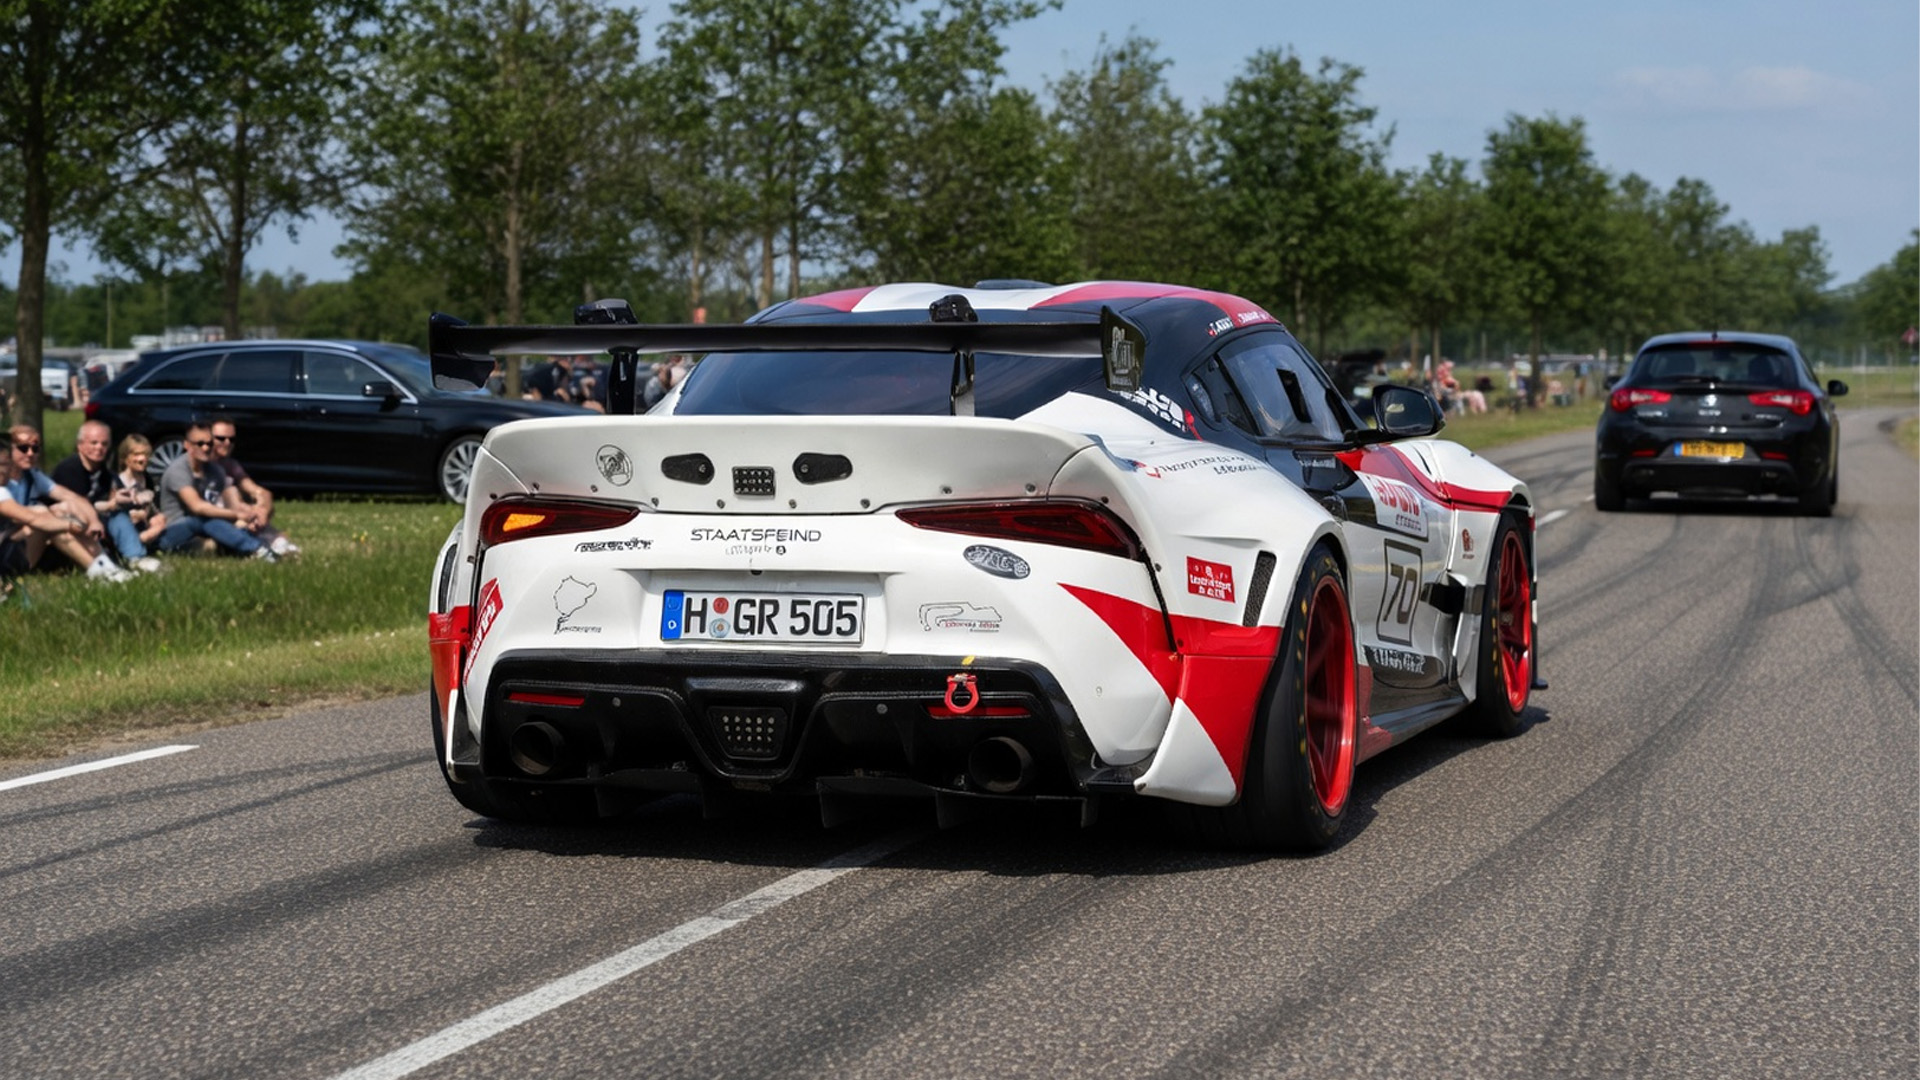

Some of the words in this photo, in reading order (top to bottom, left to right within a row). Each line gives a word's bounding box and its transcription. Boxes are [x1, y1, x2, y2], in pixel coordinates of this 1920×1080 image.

[690, 528, 822, 542] STAATSFEIND
[1382, 562, 1418, 625] 70
[684, 597, 708, 634] H
[733, 598, 780, 636] GR
[789, 600, 858, 636] 505
